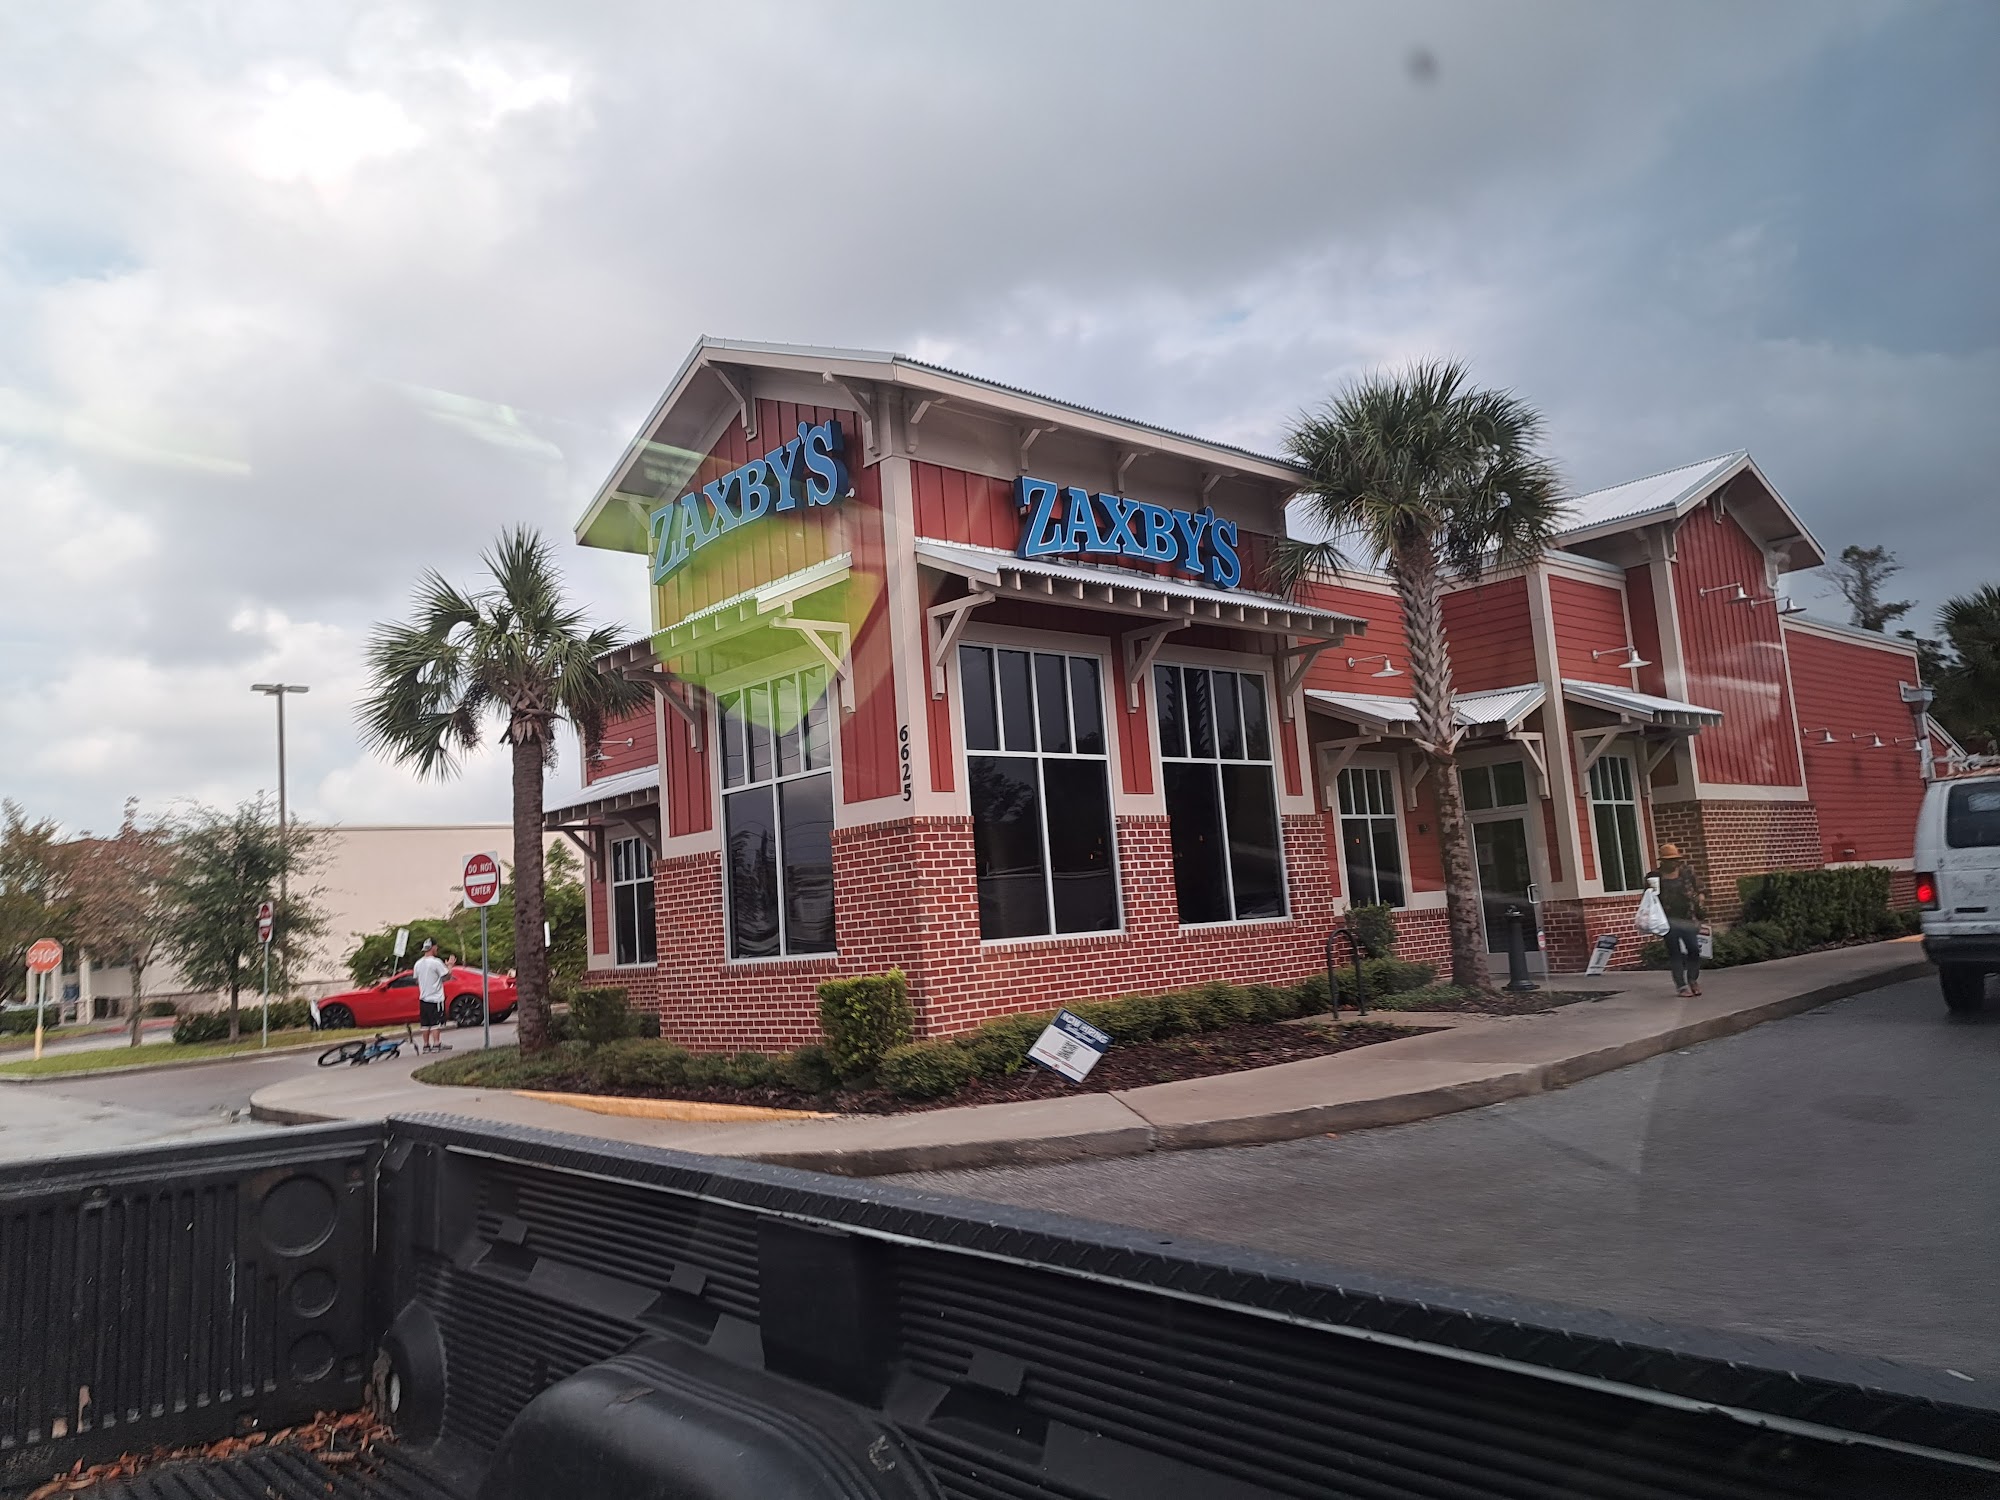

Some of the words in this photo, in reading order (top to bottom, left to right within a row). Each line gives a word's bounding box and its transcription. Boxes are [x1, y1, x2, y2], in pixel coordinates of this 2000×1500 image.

[651, 419, 839, 586] ZAXBY'S
[1018, 476, 1241, 588] ZAXBY'S
[899, 724, 912, 801] 6625
[468, 863, 478, 874] DO
[480, 861, 493, 872] NOT
[470, 884, 492, 897] ENTER
[28, 948, 61, 964] STOP
